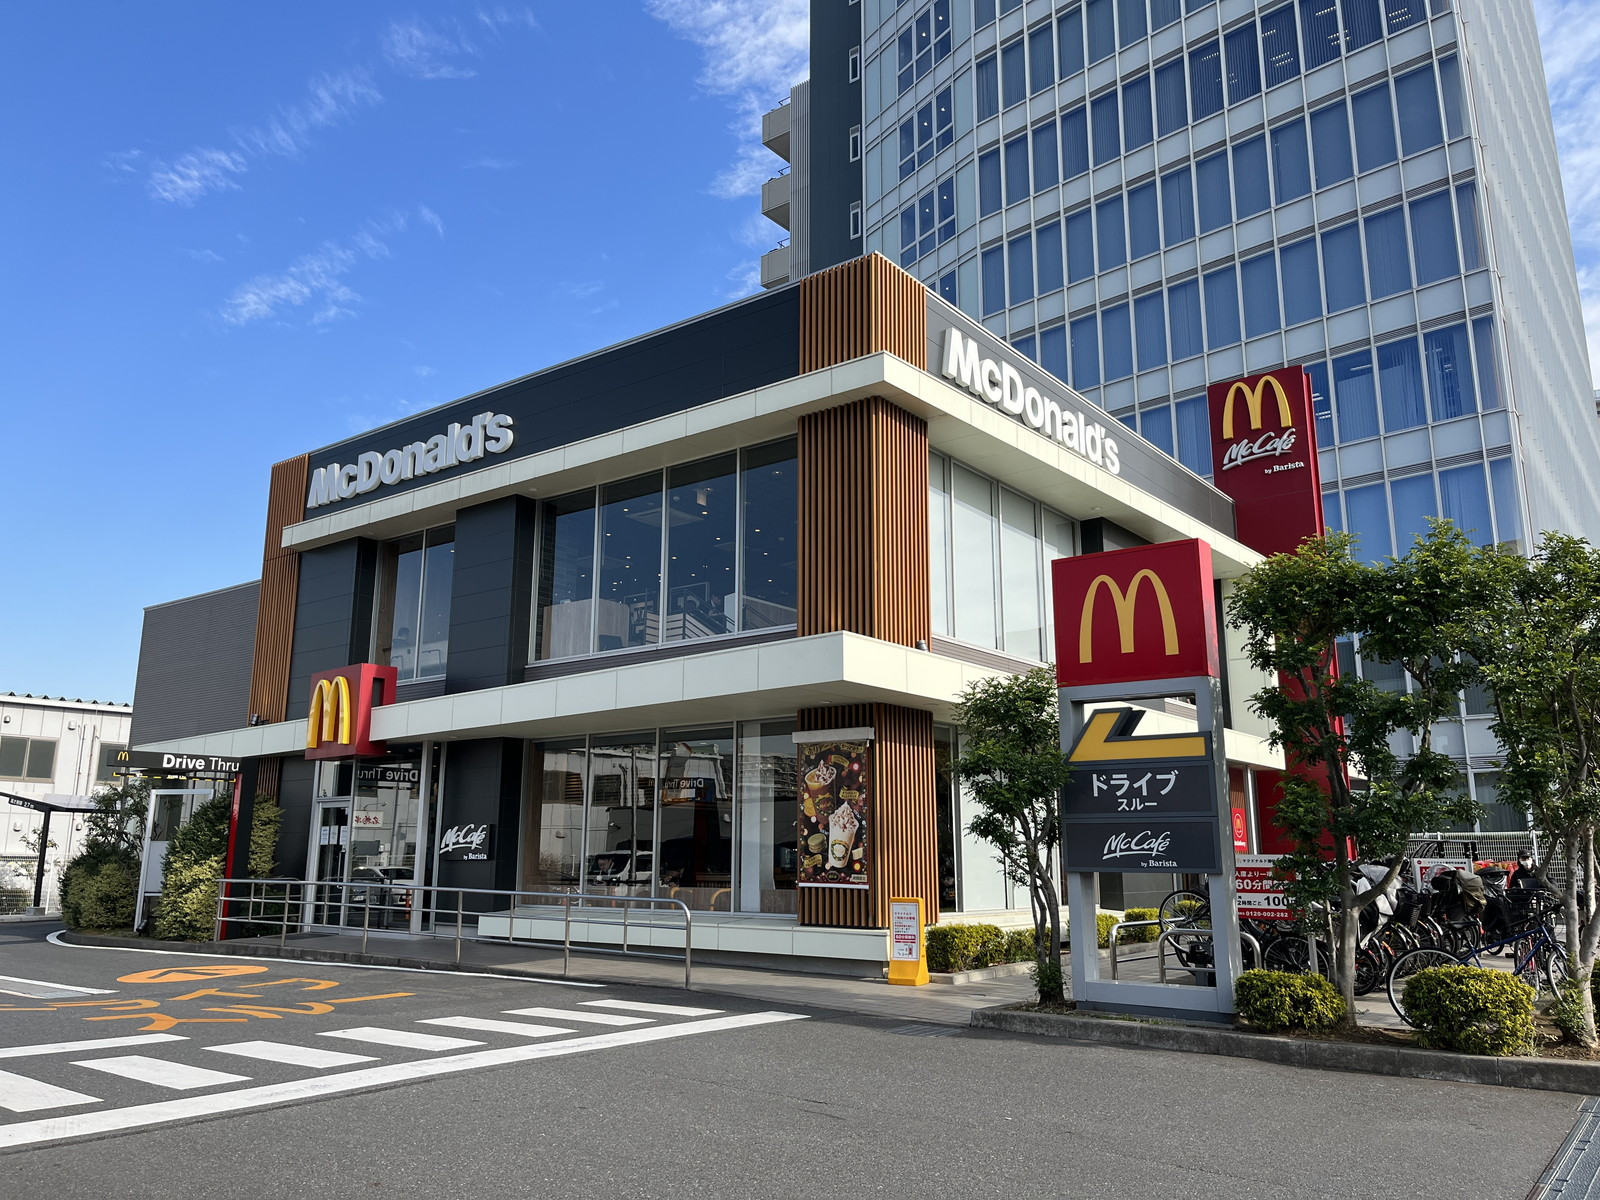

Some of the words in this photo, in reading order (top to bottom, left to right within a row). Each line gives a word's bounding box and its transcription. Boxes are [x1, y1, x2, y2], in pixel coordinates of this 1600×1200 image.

[942, 327, 1121, 475] McDonald's
[307, 411, 514, 509] McDonald's
[1222, 428, 1297, 471] McCafé
[1264, 467, 1272, 475] by
[1273, 461, 1305, 473] Barista
[162, 753, 205, 770] Drive
[209, 757, 240, 771] Thru
[1092, 770, 1179, 797] ドライブ
[1117, 798, 1158, 811] スルー
[439, 823, 488, 854] McCafé
[1102, 830, 1171, 860] McCafé
[468, 852, 488, 860] Barista
[1148, 859, 1178, 868] Barista
